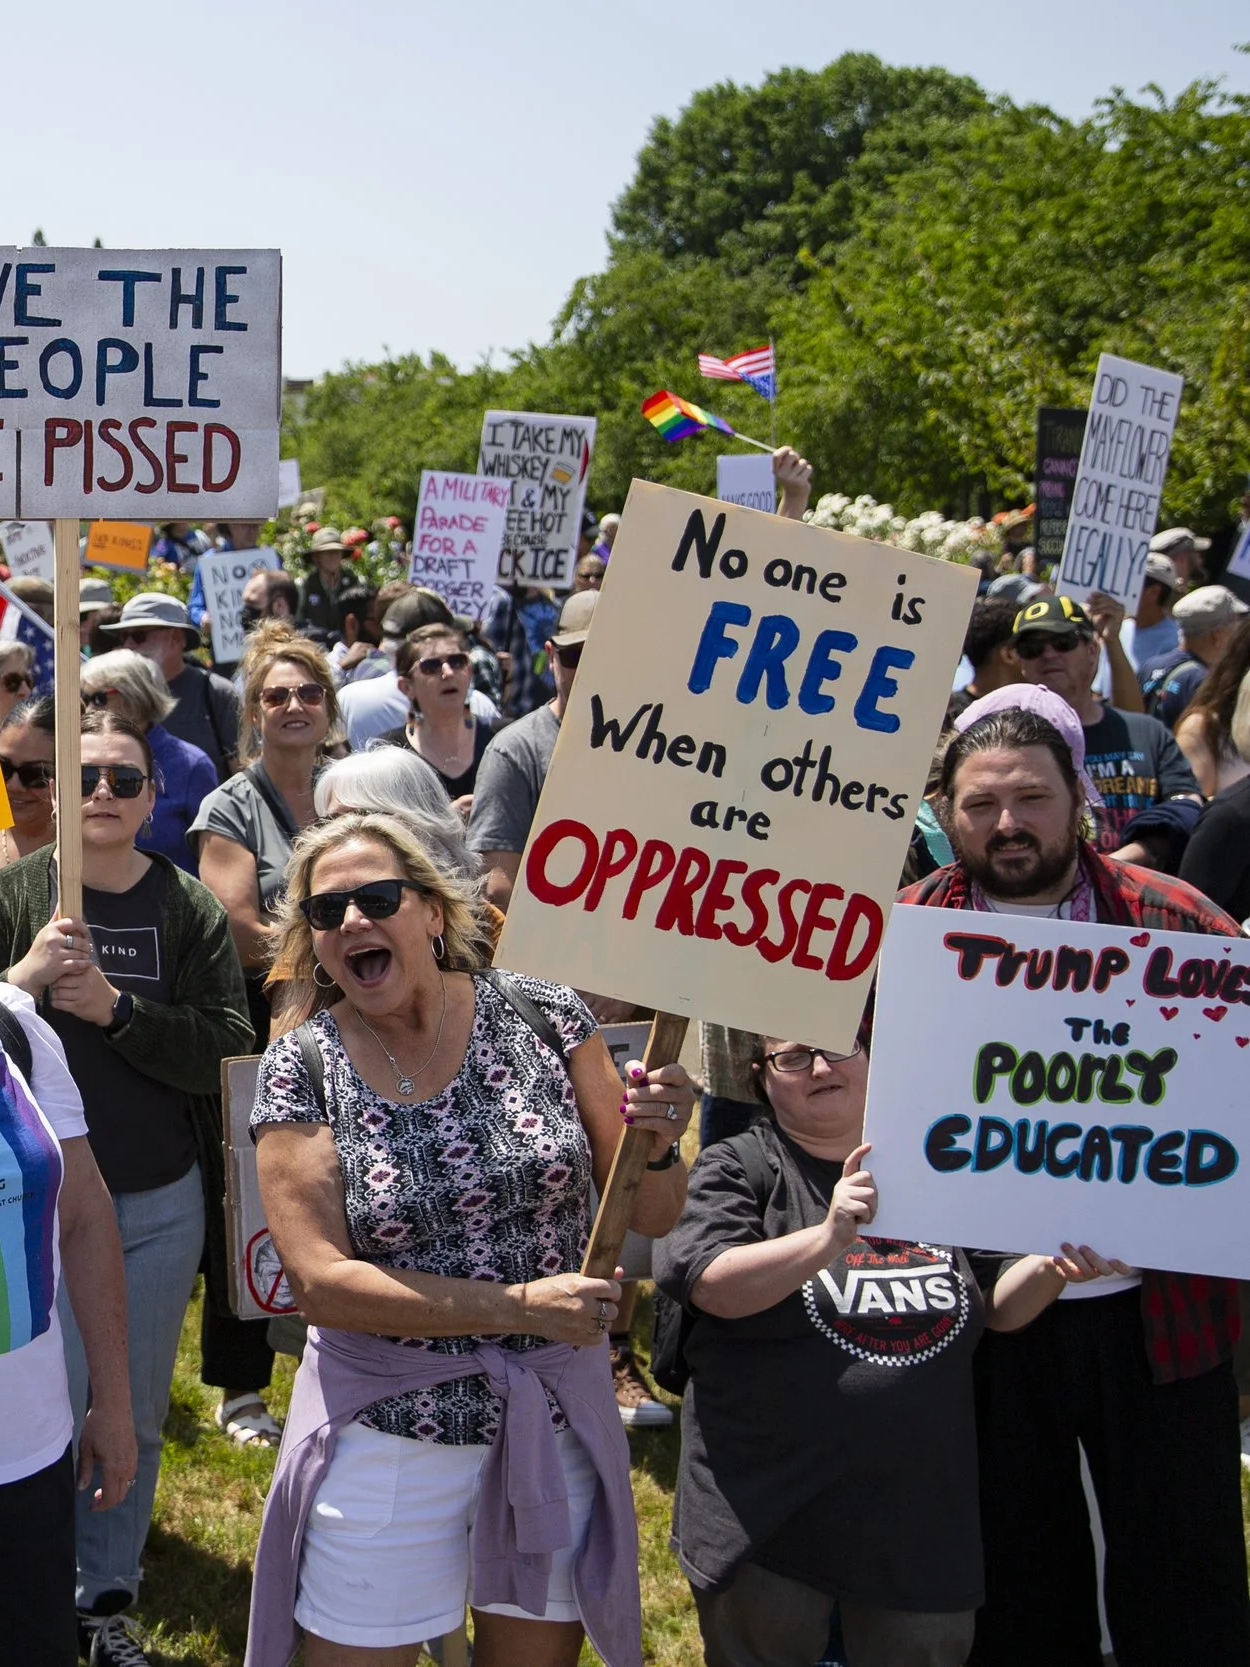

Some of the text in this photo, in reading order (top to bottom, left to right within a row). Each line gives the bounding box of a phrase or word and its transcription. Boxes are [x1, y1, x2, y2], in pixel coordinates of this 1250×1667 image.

[97, 266, 249, 331] THE
[1097, 373, 1175, 422] DID THE
[44, 417, 241, 494] PISSED
[485, 418, 586, 459] I TAKE MY
[1082, 411, 1171, 487] MAYFLOWER
[481, 451, 550, 488] WHISKEY
[424, 475, 438, 500] A
[441, 476, 510, 509] MILITARY
[539, 483, 571, 511] MY
[1073, 475, 1158, 534] COME HERE
[419, 505, 489, 533] PARADE
[530, 511, 568, 534] HOT
[418, 534, 478, 556] FOR A
[528, 548, 569, 580] ICE
[1061, 523, 1151, 599] LEGALLY?
[412, 555, 476, 579] DRAFT
[671, 508, 926, 626] No one is
[443, 597, 489, 619] AZY
[686, 600, 917, 734] FREE
[590, 693, 910, 822] When others
[1121, 759, 1136, 777] A
[690, 798, 772, 842] are
[525, 818, 885, 982] OPPRESSED
[102, 945, 137, 957] KIND
[924, 1114, 1240, 1187] EDUCATED
[845, 1250, 911, 1268] Off The Wall
[817, 1263, 957, 1314] VANS
[856, 1333, 888, 1353] AFTER
[889, 1339, 911, 1354] YOU
[913, 1333, 934, 1350] ARE
